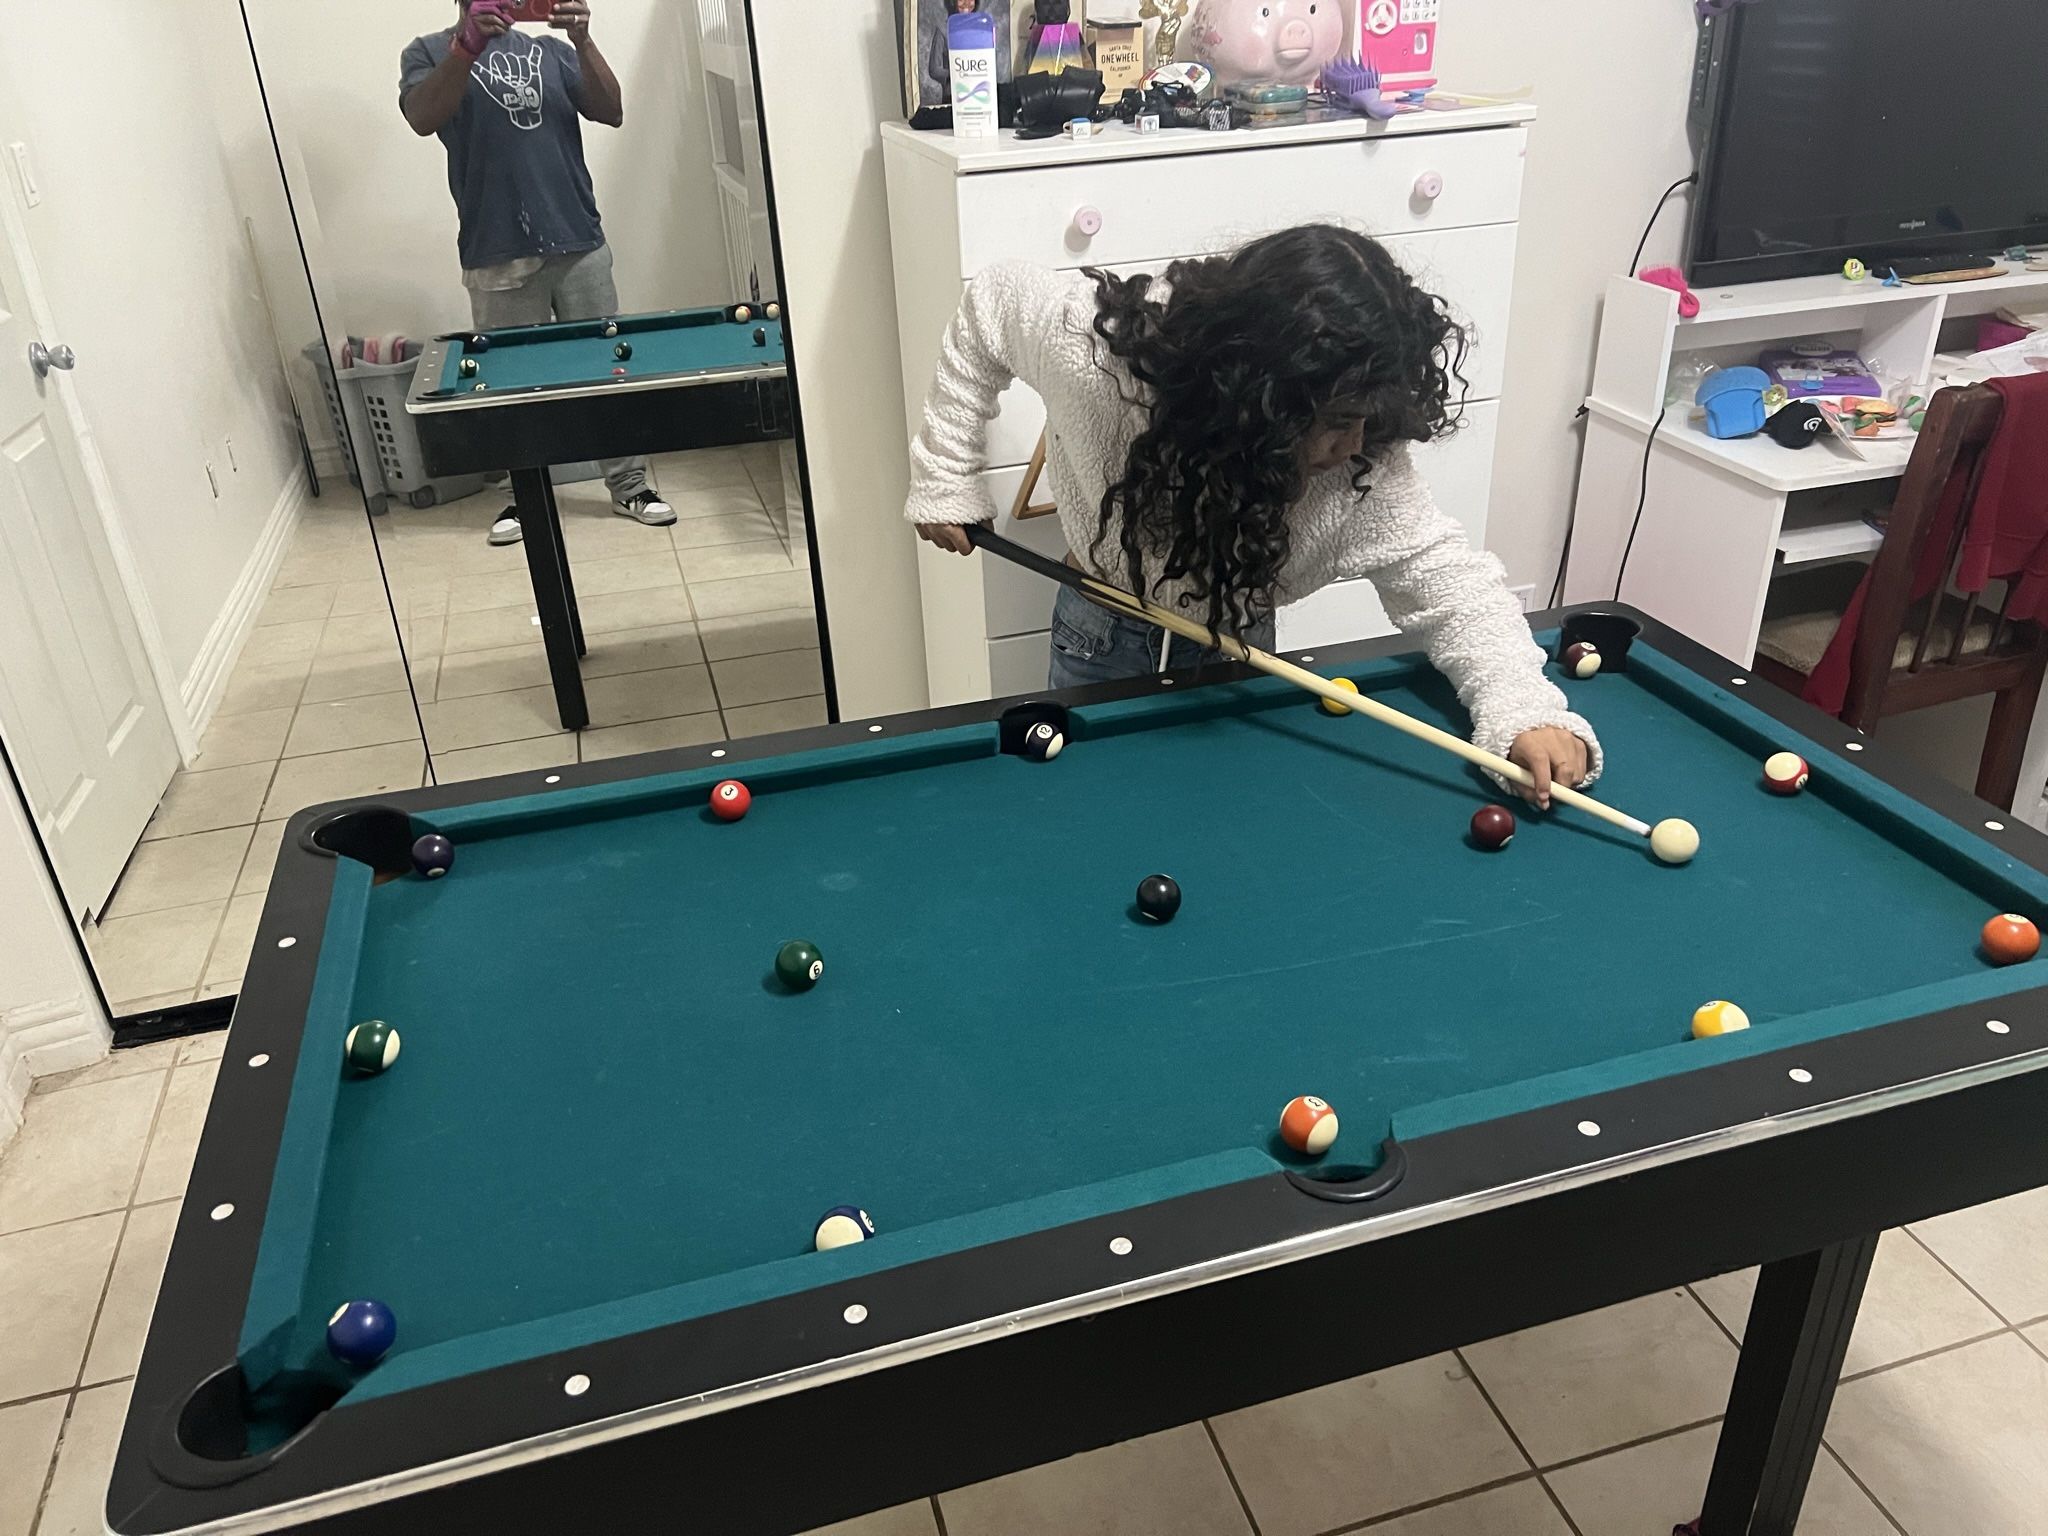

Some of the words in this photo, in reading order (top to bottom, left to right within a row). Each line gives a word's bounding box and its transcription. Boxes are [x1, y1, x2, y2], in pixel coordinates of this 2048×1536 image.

[1101, 52, 1139, 64] ONEWHEEL
[1039, 726, 1051, 736] 12
[724, 786, 734, 796] 3
[813, 964, 821, 977] 6
